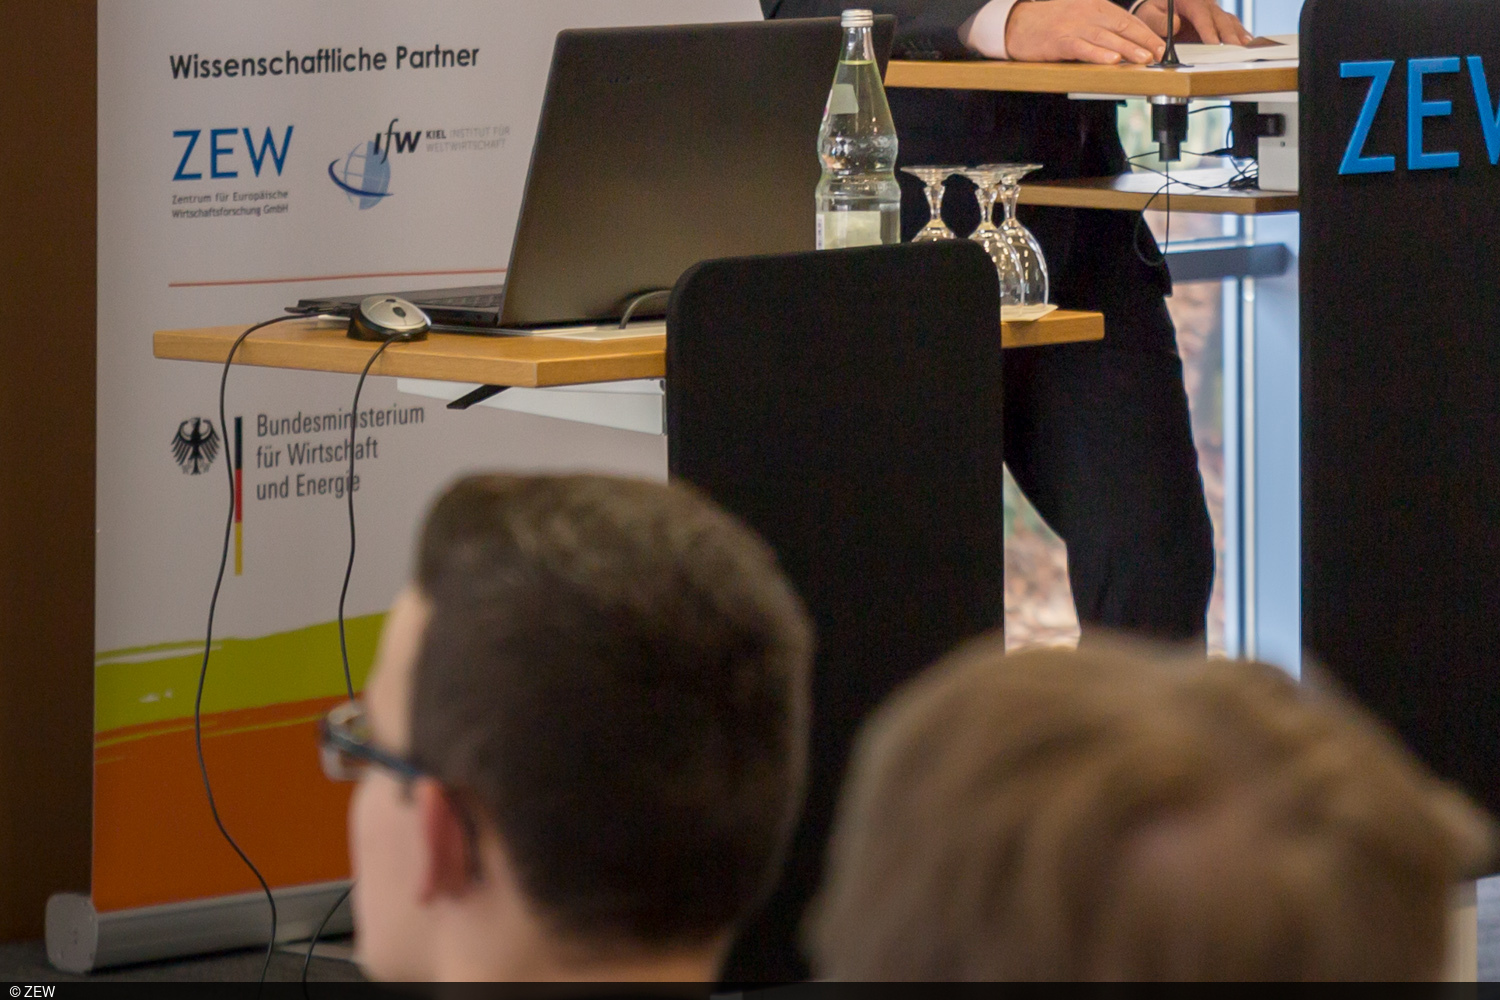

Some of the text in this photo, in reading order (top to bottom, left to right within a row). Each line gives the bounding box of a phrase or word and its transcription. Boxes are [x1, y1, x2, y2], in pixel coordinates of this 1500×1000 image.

[170, 44, 480, 80] Wissenschaftliche Partner
[426, 129, 447, 140] KIEL
[172, 125, 294, 181] ZEW
[172, 190, 288, 205] Zentrum für Europäische
[263, 203, 289, 214] GmbH
[257, 403, 425, 437] Bundesministerium
[256, 436, 379, 469] für Wirtschaft
[256, 470, 360, 500] und Energie
